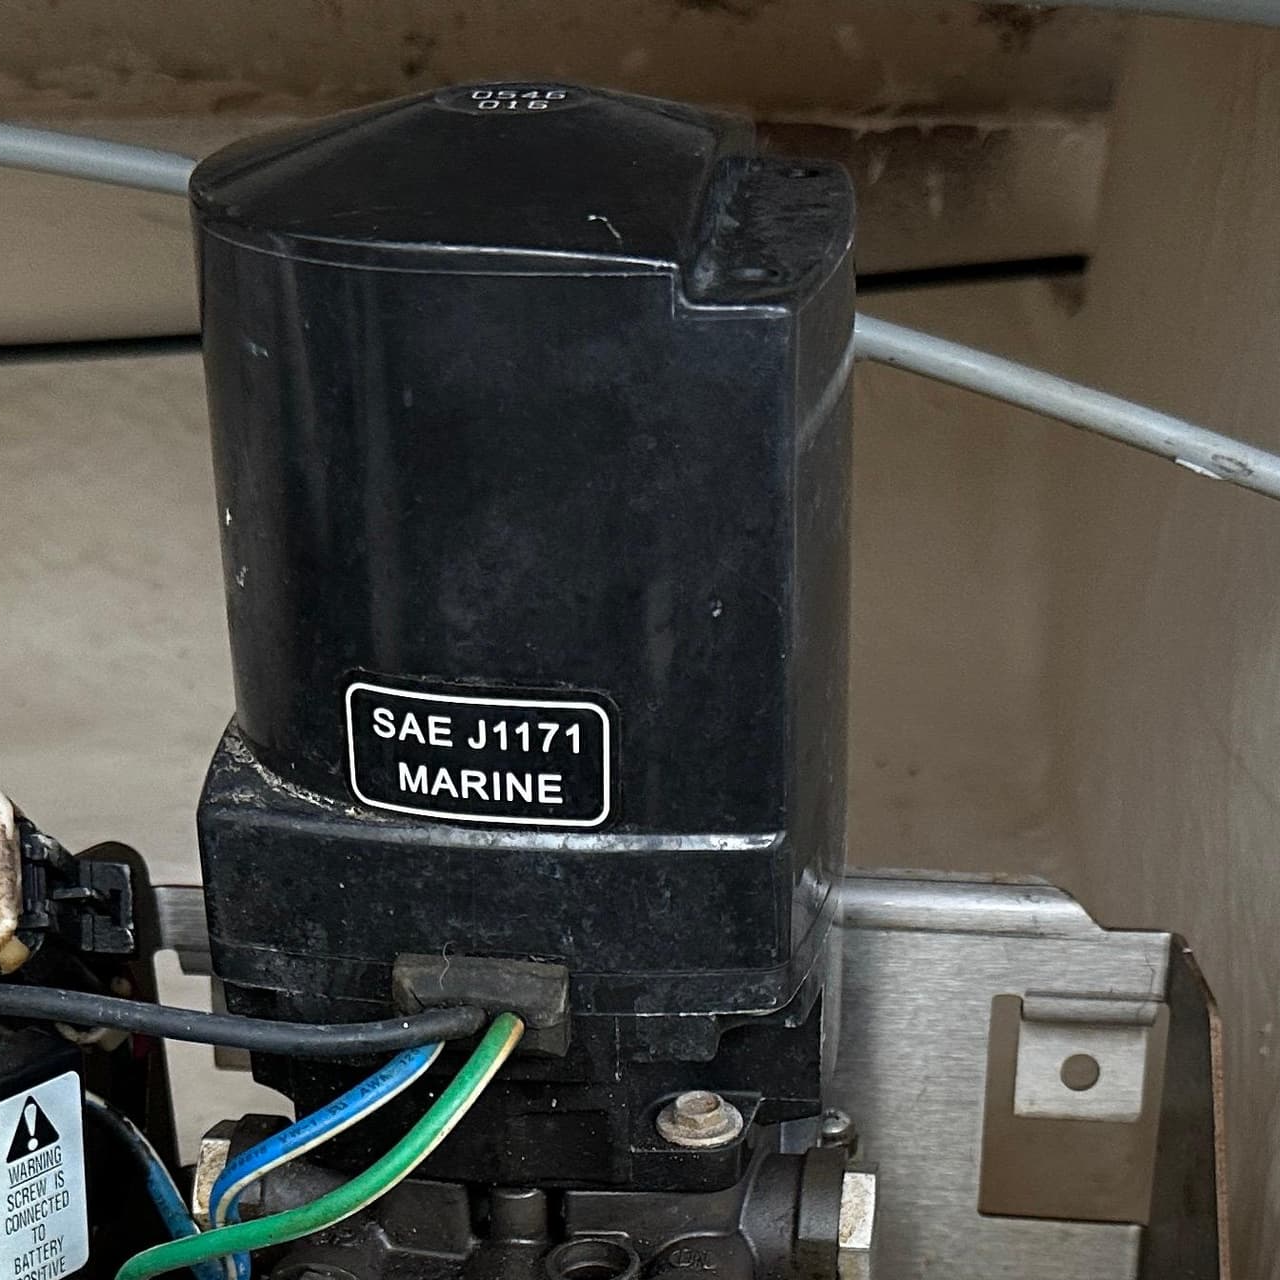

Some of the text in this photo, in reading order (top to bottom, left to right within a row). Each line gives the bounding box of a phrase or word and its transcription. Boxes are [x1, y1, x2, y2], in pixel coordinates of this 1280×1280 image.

[372, 707, 580, 754] SAE J1171
[398, 761, 564, 804] MARINE
[8, 1145, 62, 1186] WARNING
[7, 1169, 65, 1213] SCREW IS
[4, 1190, 70, 1236] CONNECTED
[31, 1223, 46, 1245] TO
[13, 1235, 65, 1276] BATTERY
